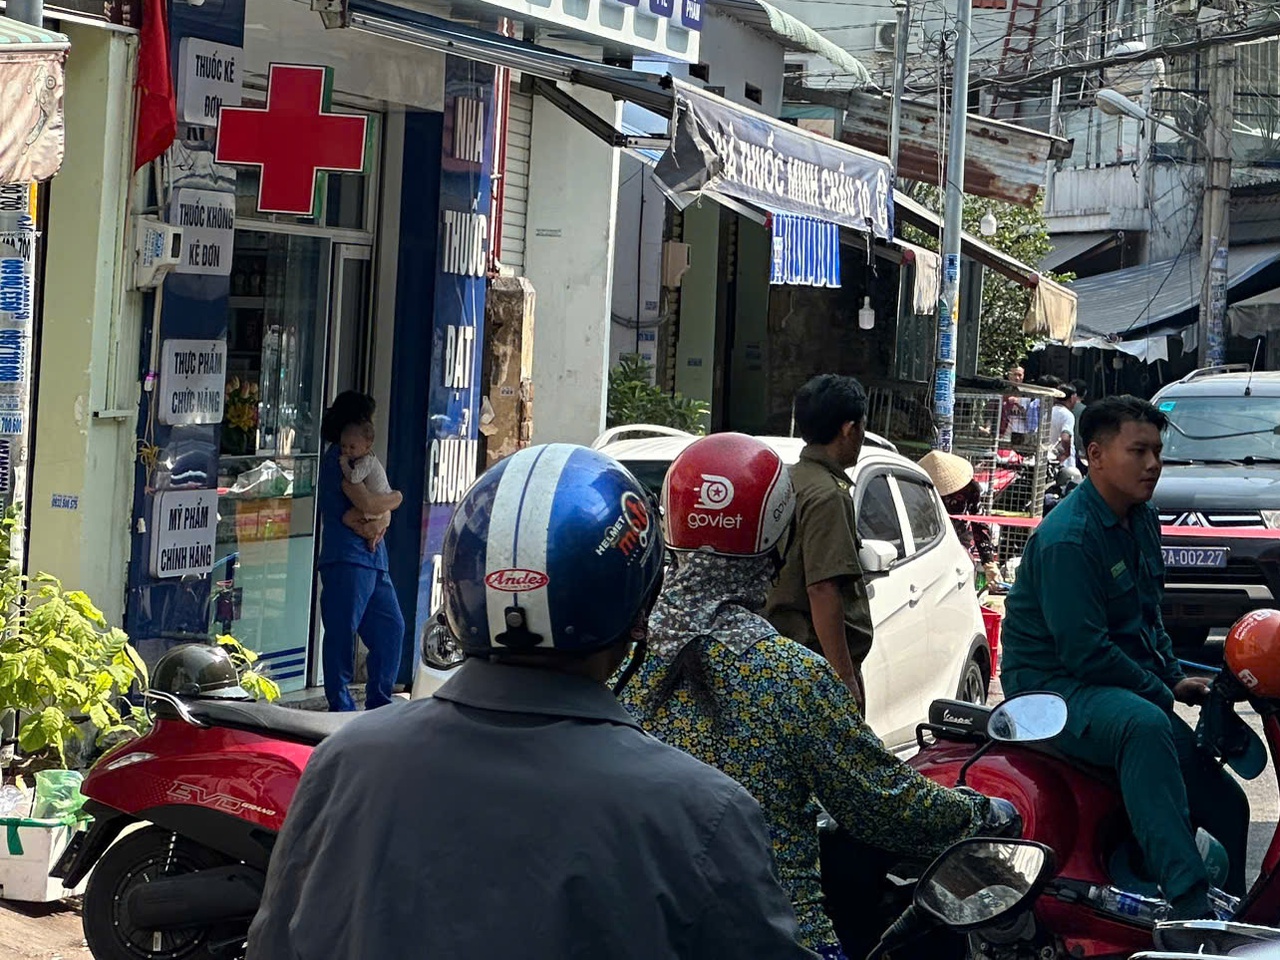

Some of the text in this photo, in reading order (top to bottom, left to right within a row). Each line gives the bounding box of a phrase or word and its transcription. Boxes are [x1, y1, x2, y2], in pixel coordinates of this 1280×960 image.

[195, 50, 235, 84] THUỐC KÊ
[454, 87, 484, 163] NHÀ
[740, 130, 785, 197] THUỐC
[787, 156, 819, 207] MINH
[821, 161, 855, 216] CHÂU
[179, 195, 234, 230] THUỐC KHÔNG
[443, 191, 487, 278] THUỐC
[188, 240, 201, 267] KÊ
[201, 244, 220, 268] ĐƠN
[174, 343, 222, 377] THỰC PHẨM
[444, 325, 475, 401] ĐẠT
[171, 388, 220, 415] CHỨC NĂNG
[428, 408, 478, 504] CHUẨN
[168, 496, 209, 531] MỸ PHẨM
[687, 512, 742, 529] goviet
[595, 515, 627, 556] HELMET
[160, 543, 187, 572] CHÍNH
[489, 569, 545, 586] Andes
